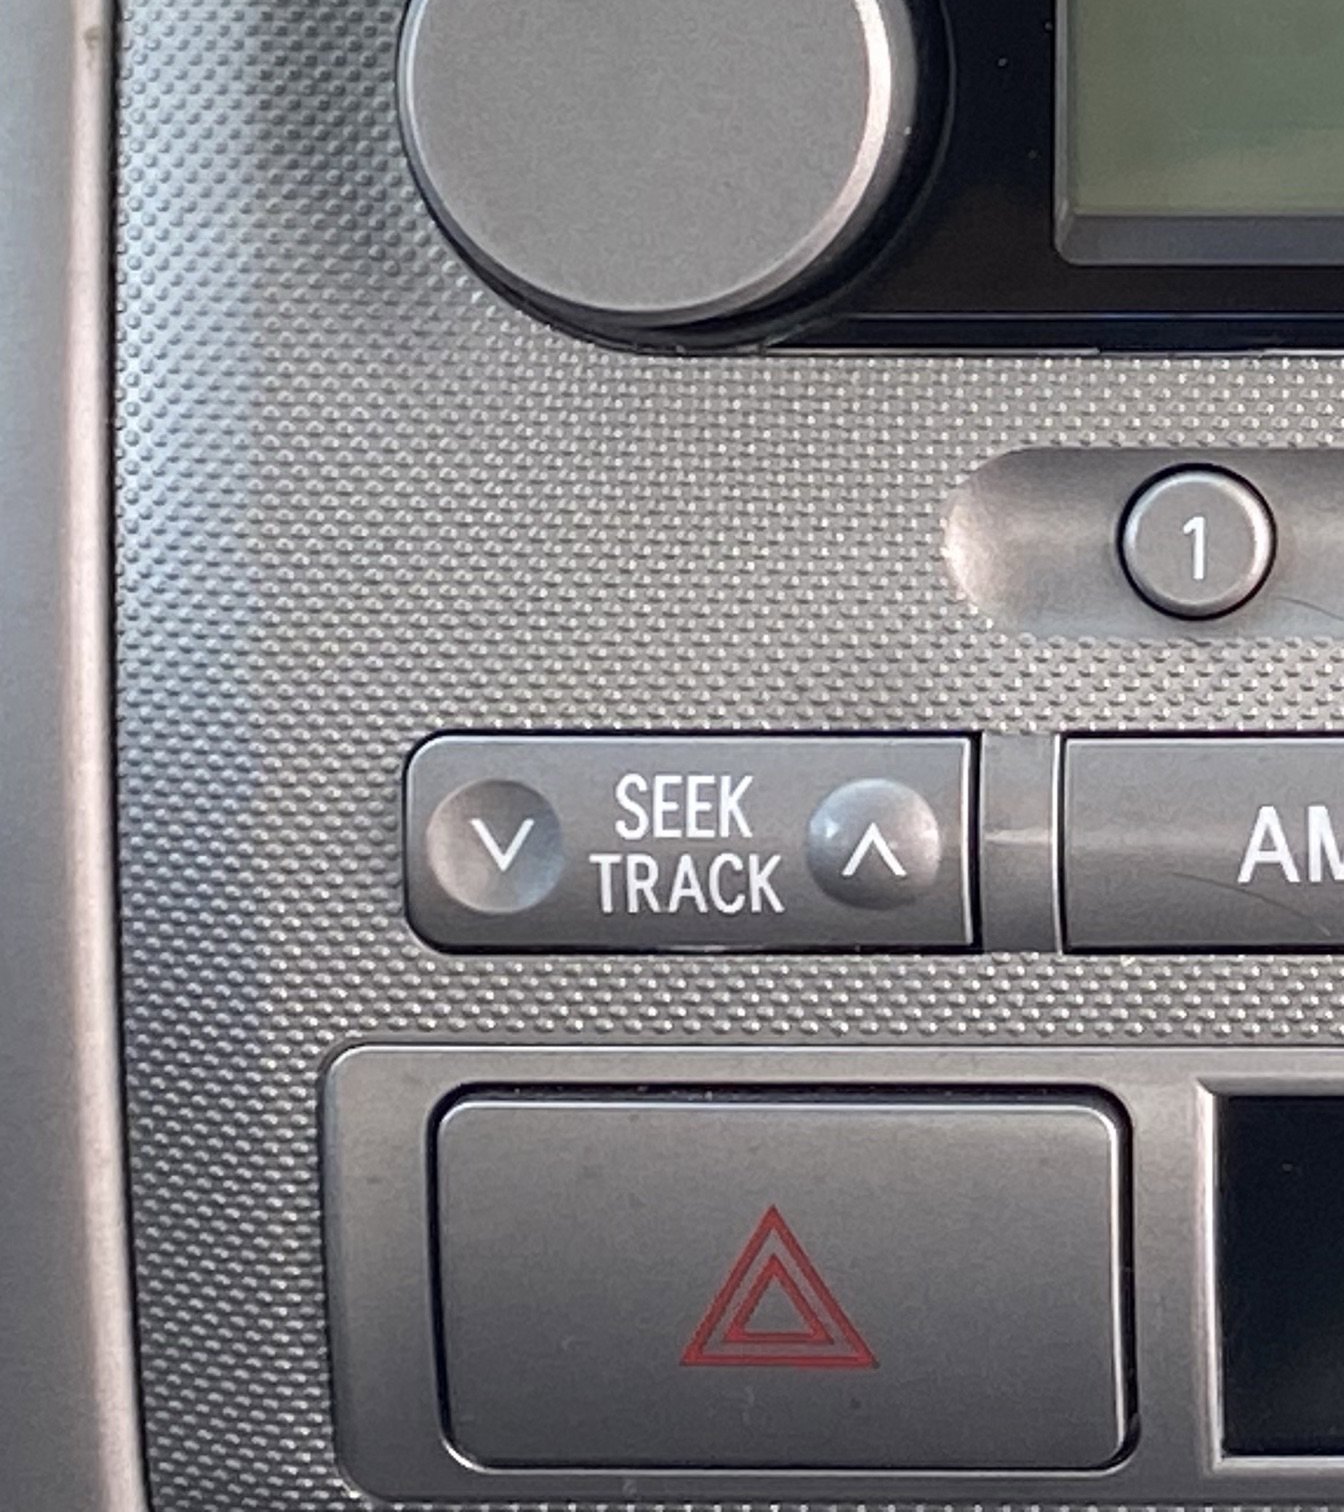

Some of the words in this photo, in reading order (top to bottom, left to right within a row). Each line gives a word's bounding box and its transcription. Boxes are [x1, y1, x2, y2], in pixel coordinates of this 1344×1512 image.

[1180, 515, 1207, 580] 1
[614, 773, 754, 841] SEEK
[589, 853, 785, 914] TRACK
